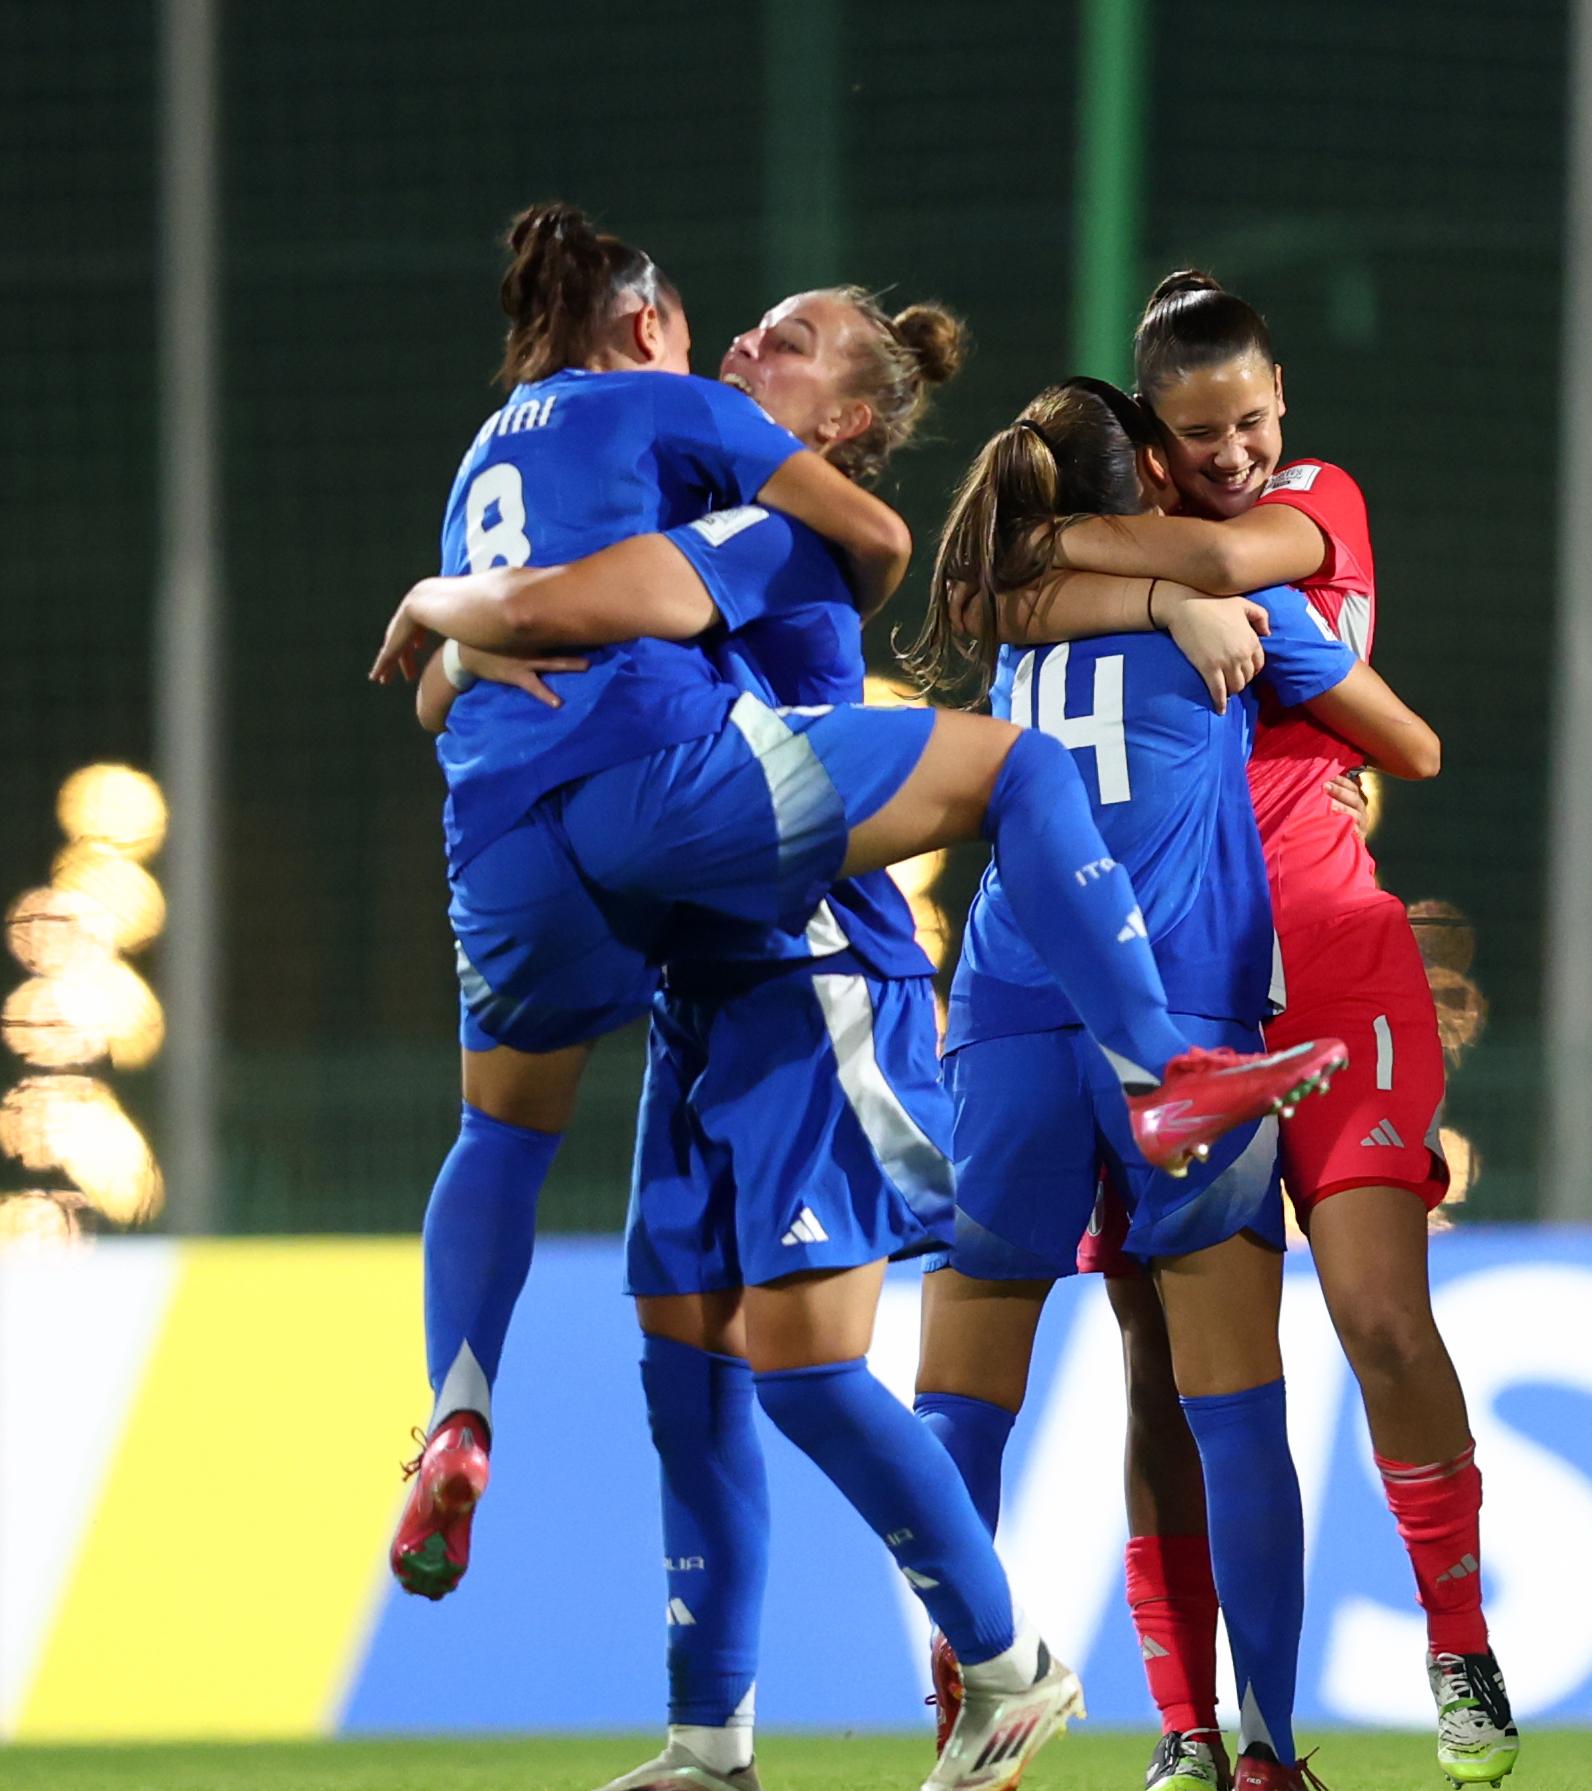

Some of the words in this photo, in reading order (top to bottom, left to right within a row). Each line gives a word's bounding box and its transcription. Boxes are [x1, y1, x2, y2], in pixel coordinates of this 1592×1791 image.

[466, 462, 531, 574] 8
[1011, 641, 1131, 805] 14
[1373, 1014, 1393, 1091] 1
